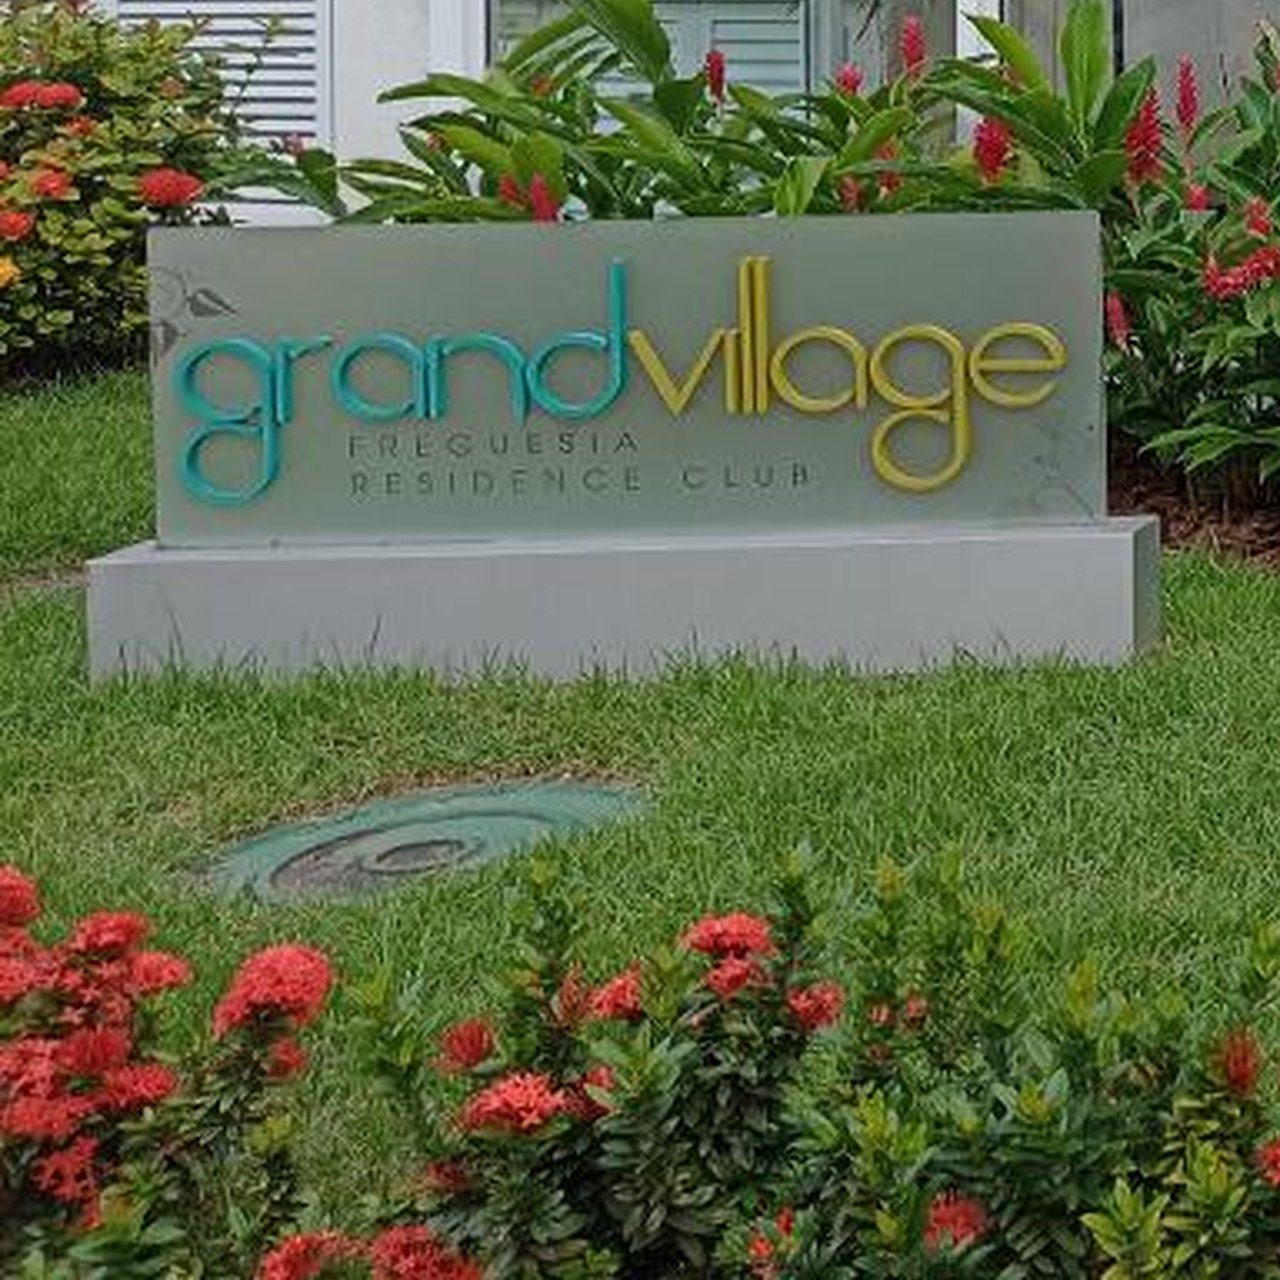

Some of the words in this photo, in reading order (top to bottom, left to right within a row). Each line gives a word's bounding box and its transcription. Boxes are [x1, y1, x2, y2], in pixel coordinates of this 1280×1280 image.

[348, 431, 640, 459] FREGUESIA
[349, 465, 642, 497] RESIDENCE
[681, 460, 809, 490] CLUB
